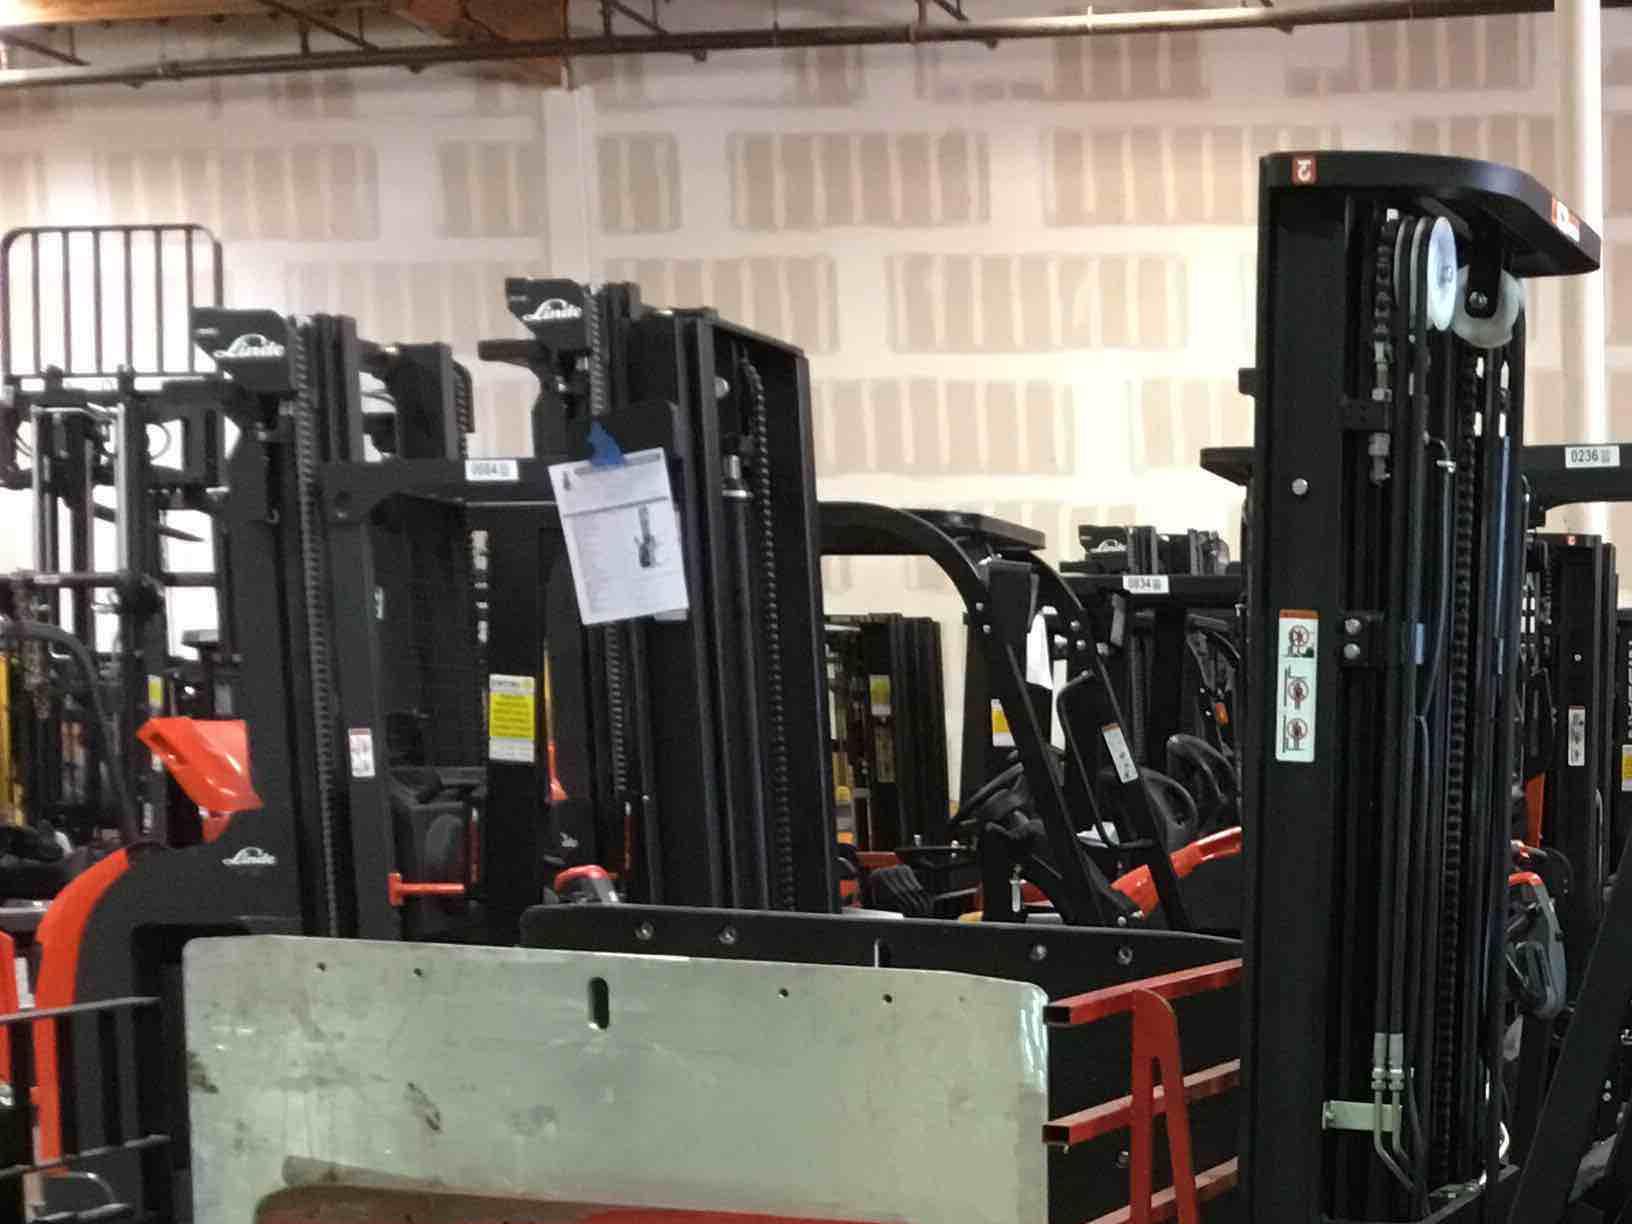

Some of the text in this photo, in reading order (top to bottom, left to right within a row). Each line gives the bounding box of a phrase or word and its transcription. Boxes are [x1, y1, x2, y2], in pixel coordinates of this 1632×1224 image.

[522, 298, 582, 321] Linde
[213, 333, 285, 358] Linde
[1570, 448, 1600, 463] 0236
[221, 846, 276, 866] Linde
